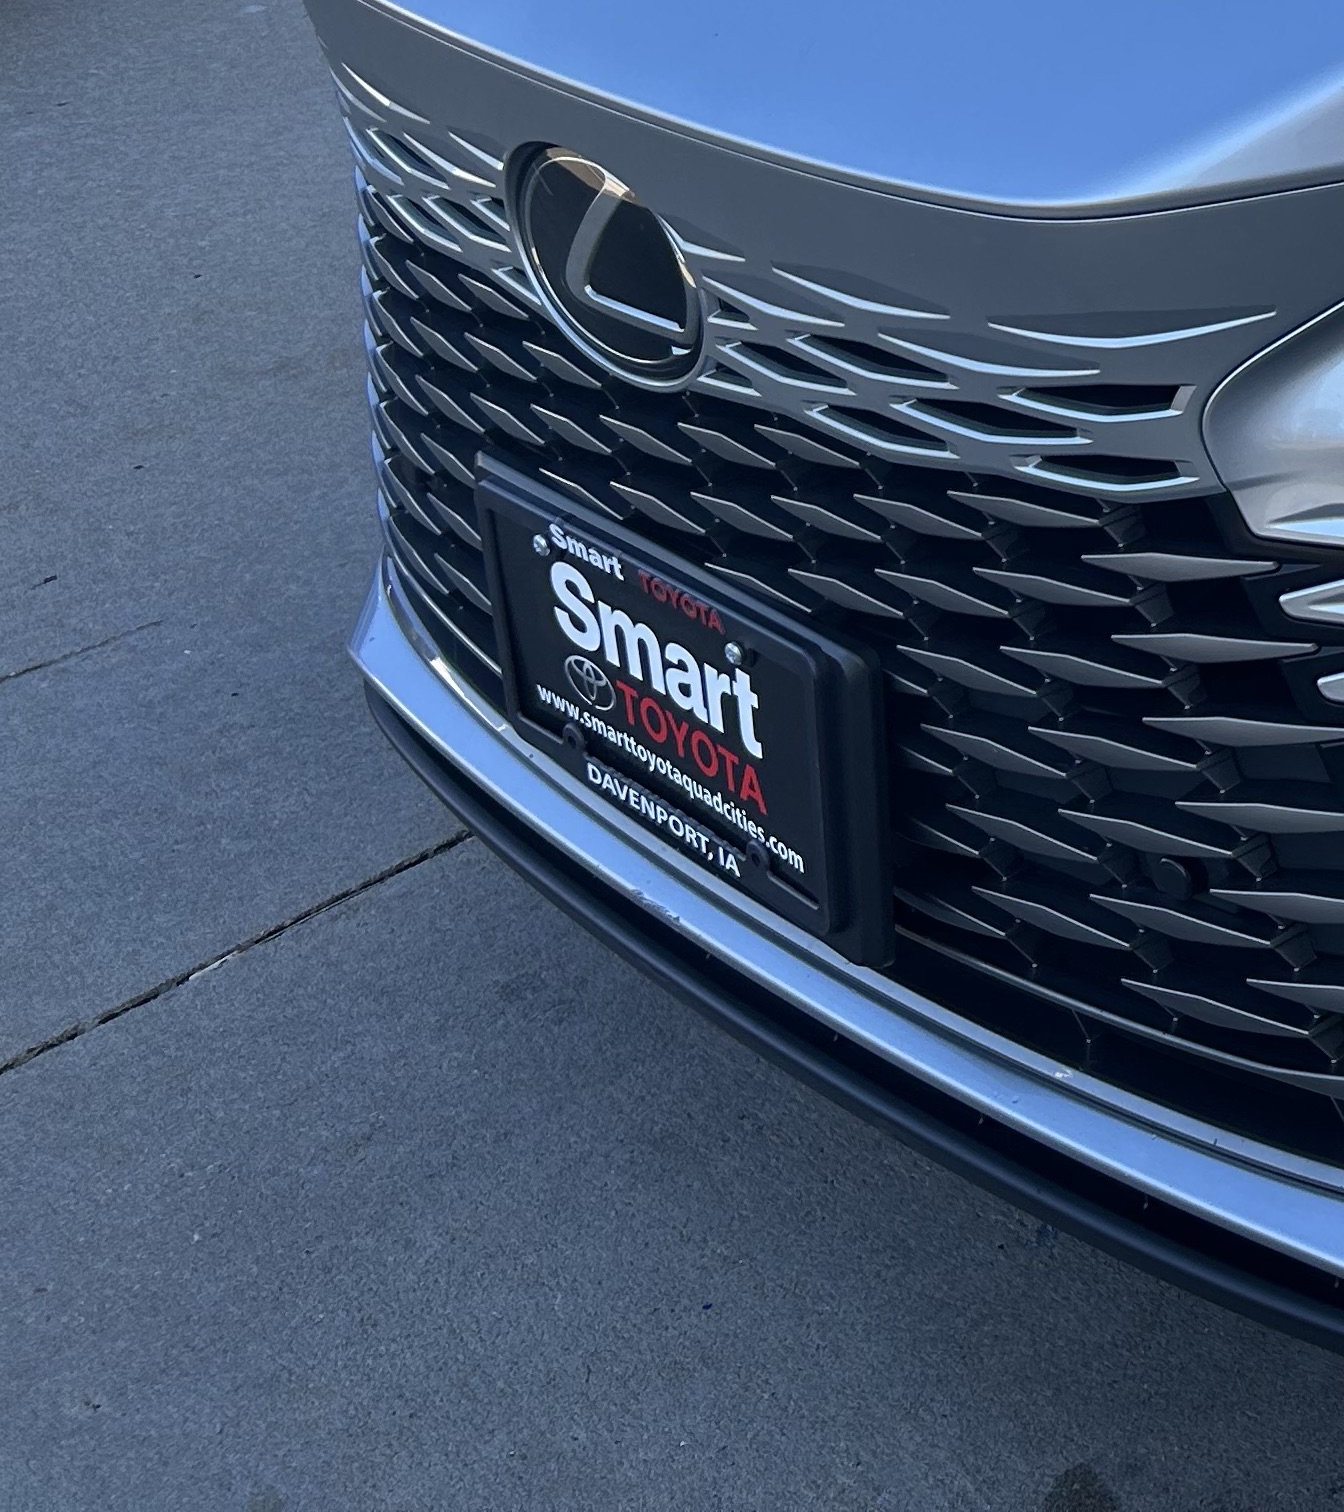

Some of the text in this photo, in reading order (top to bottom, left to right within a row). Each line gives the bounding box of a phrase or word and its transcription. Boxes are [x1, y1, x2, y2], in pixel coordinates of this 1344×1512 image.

[549, 523, 625, 581] Smart
[637, 569, 726, 635] TOYOTA
[550, 561, 763, 759] Smart
[536, 684, 805, 874] www.smarttoyotaquadcities.com
[615, 680, 768, 816] TOYOTA
[586, 762, 741, 877] DAVENPORT, IA
